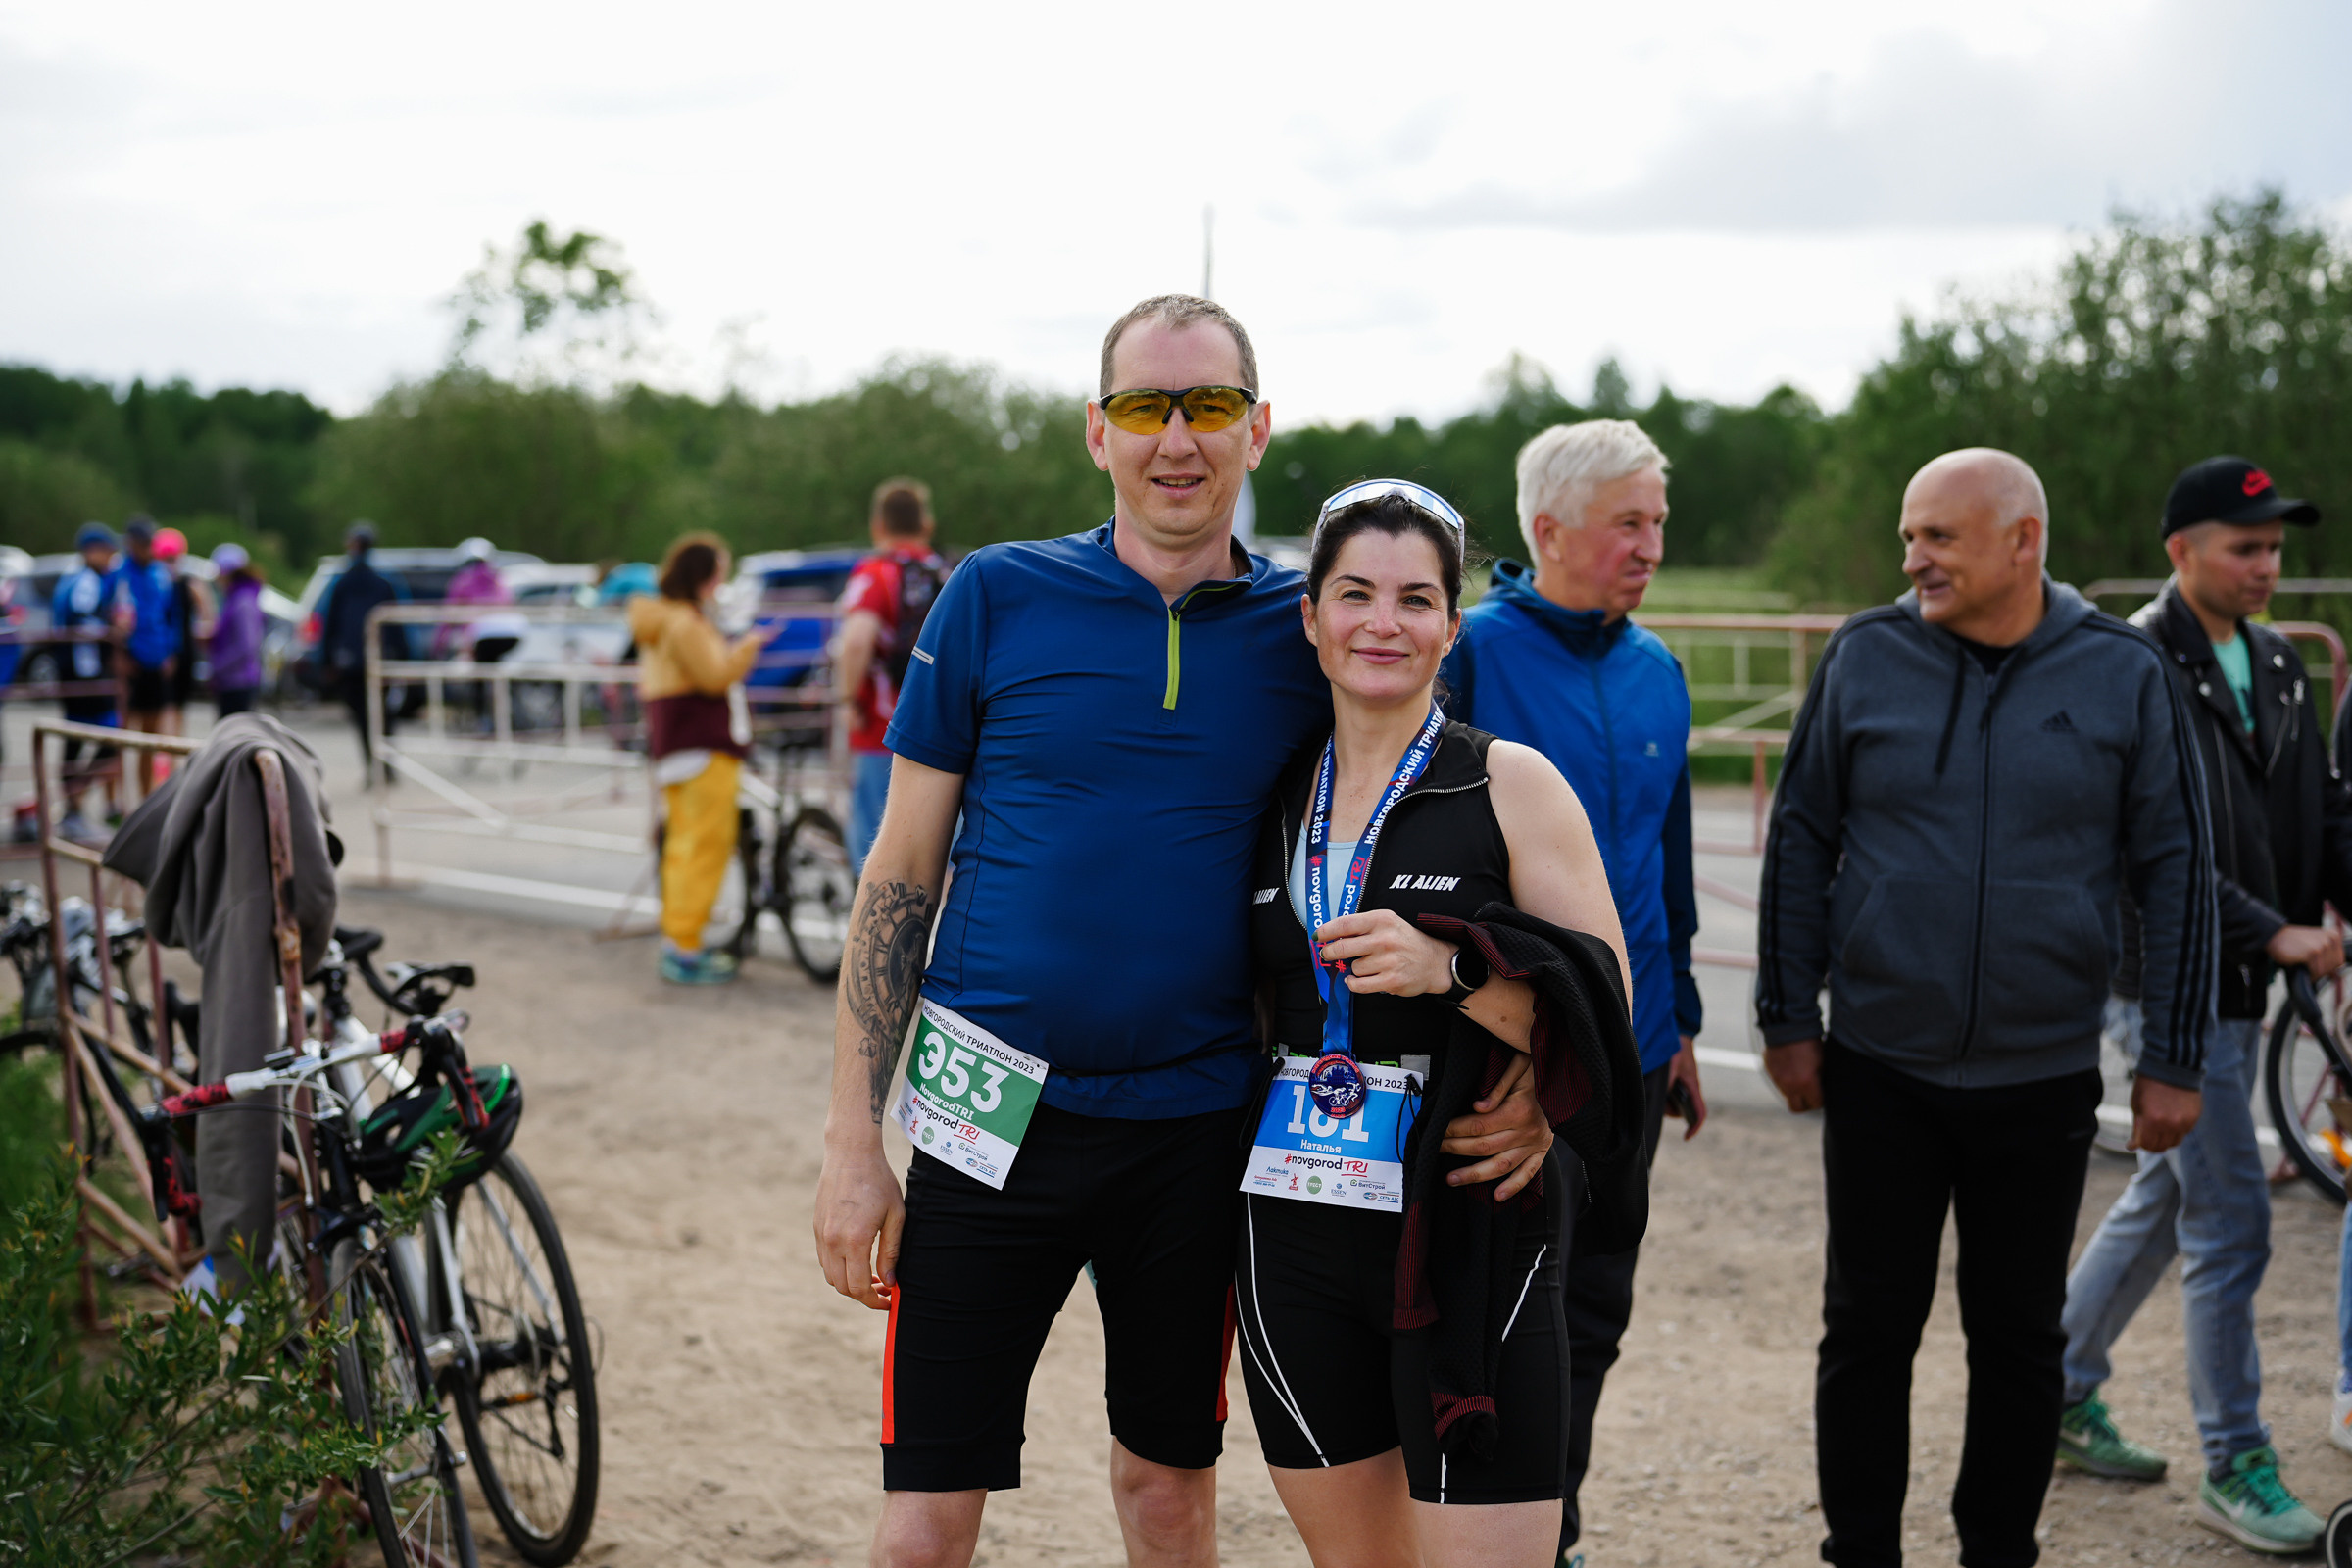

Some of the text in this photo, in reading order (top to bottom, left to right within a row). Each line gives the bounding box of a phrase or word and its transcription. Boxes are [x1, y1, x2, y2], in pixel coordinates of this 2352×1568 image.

[1315, 753, 1330, 813] ТРИАТЛОН
[1311, 814, 1324, 845] 2023
[1389, 874, 1461, 892] KL ALIEN
[924, 1004, 1035, 1075] НОВГОРОДСКИЙ ТРИАТЛОН 2023
[1384, 1078, 1407, 1090] 2023
[919, 1082, 975, 1121] NovgorodTRI
[1300, 1139, 1342, 1154] Наталья
